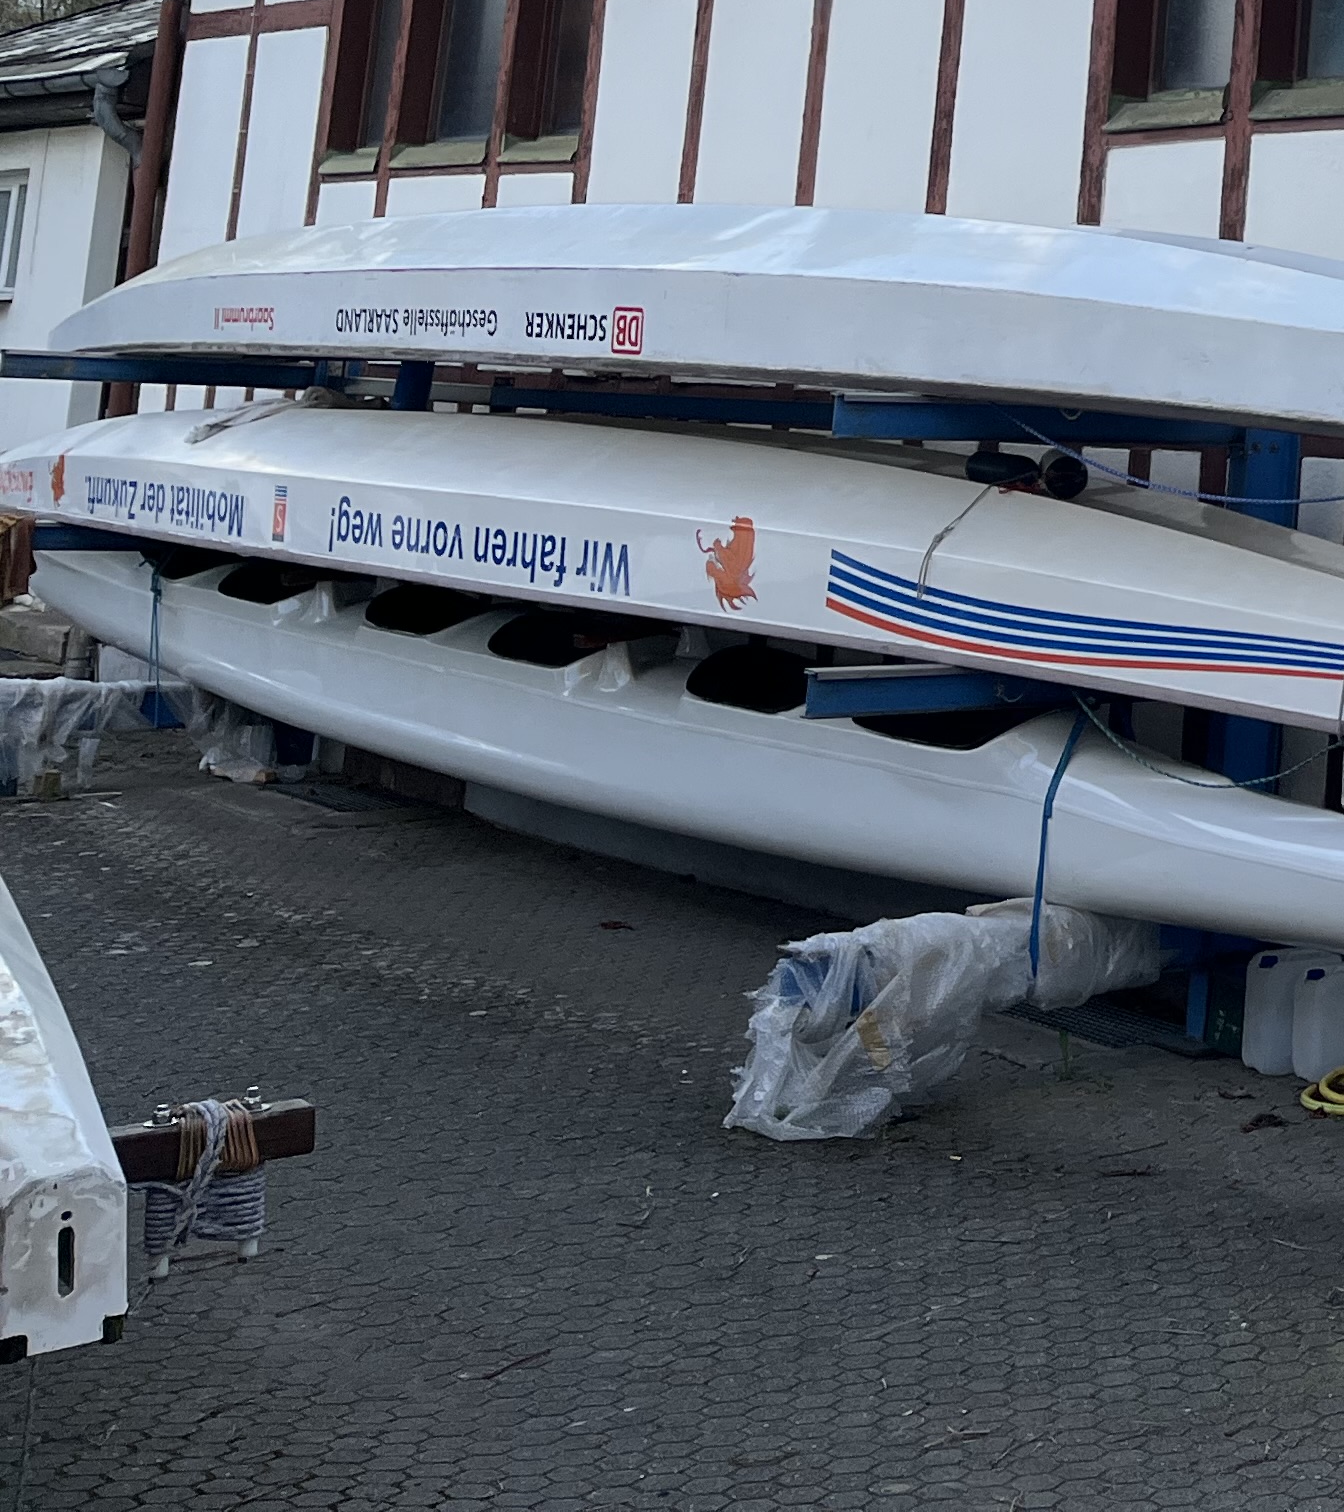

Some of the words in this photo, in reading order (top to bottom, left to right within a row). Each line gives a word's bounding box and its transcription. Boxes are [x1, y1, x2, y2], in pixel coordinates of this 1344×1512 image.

[336, 308, 399, 335] SAARLAND
[403, 308, 498, 337] Geschäftsstelle
[525, 311, 608, 341] SCHENKER
[615, 314, 641, 348] DB
[140, 483, 165, 524] der
[169, 484, 245, 538] Mobilität
[328, 496, 383, 553] weg!
[391, 514, 463, 560] vorne
[474, 526, 567, 588] fahren
[576, 540, 631, 597] Wir
